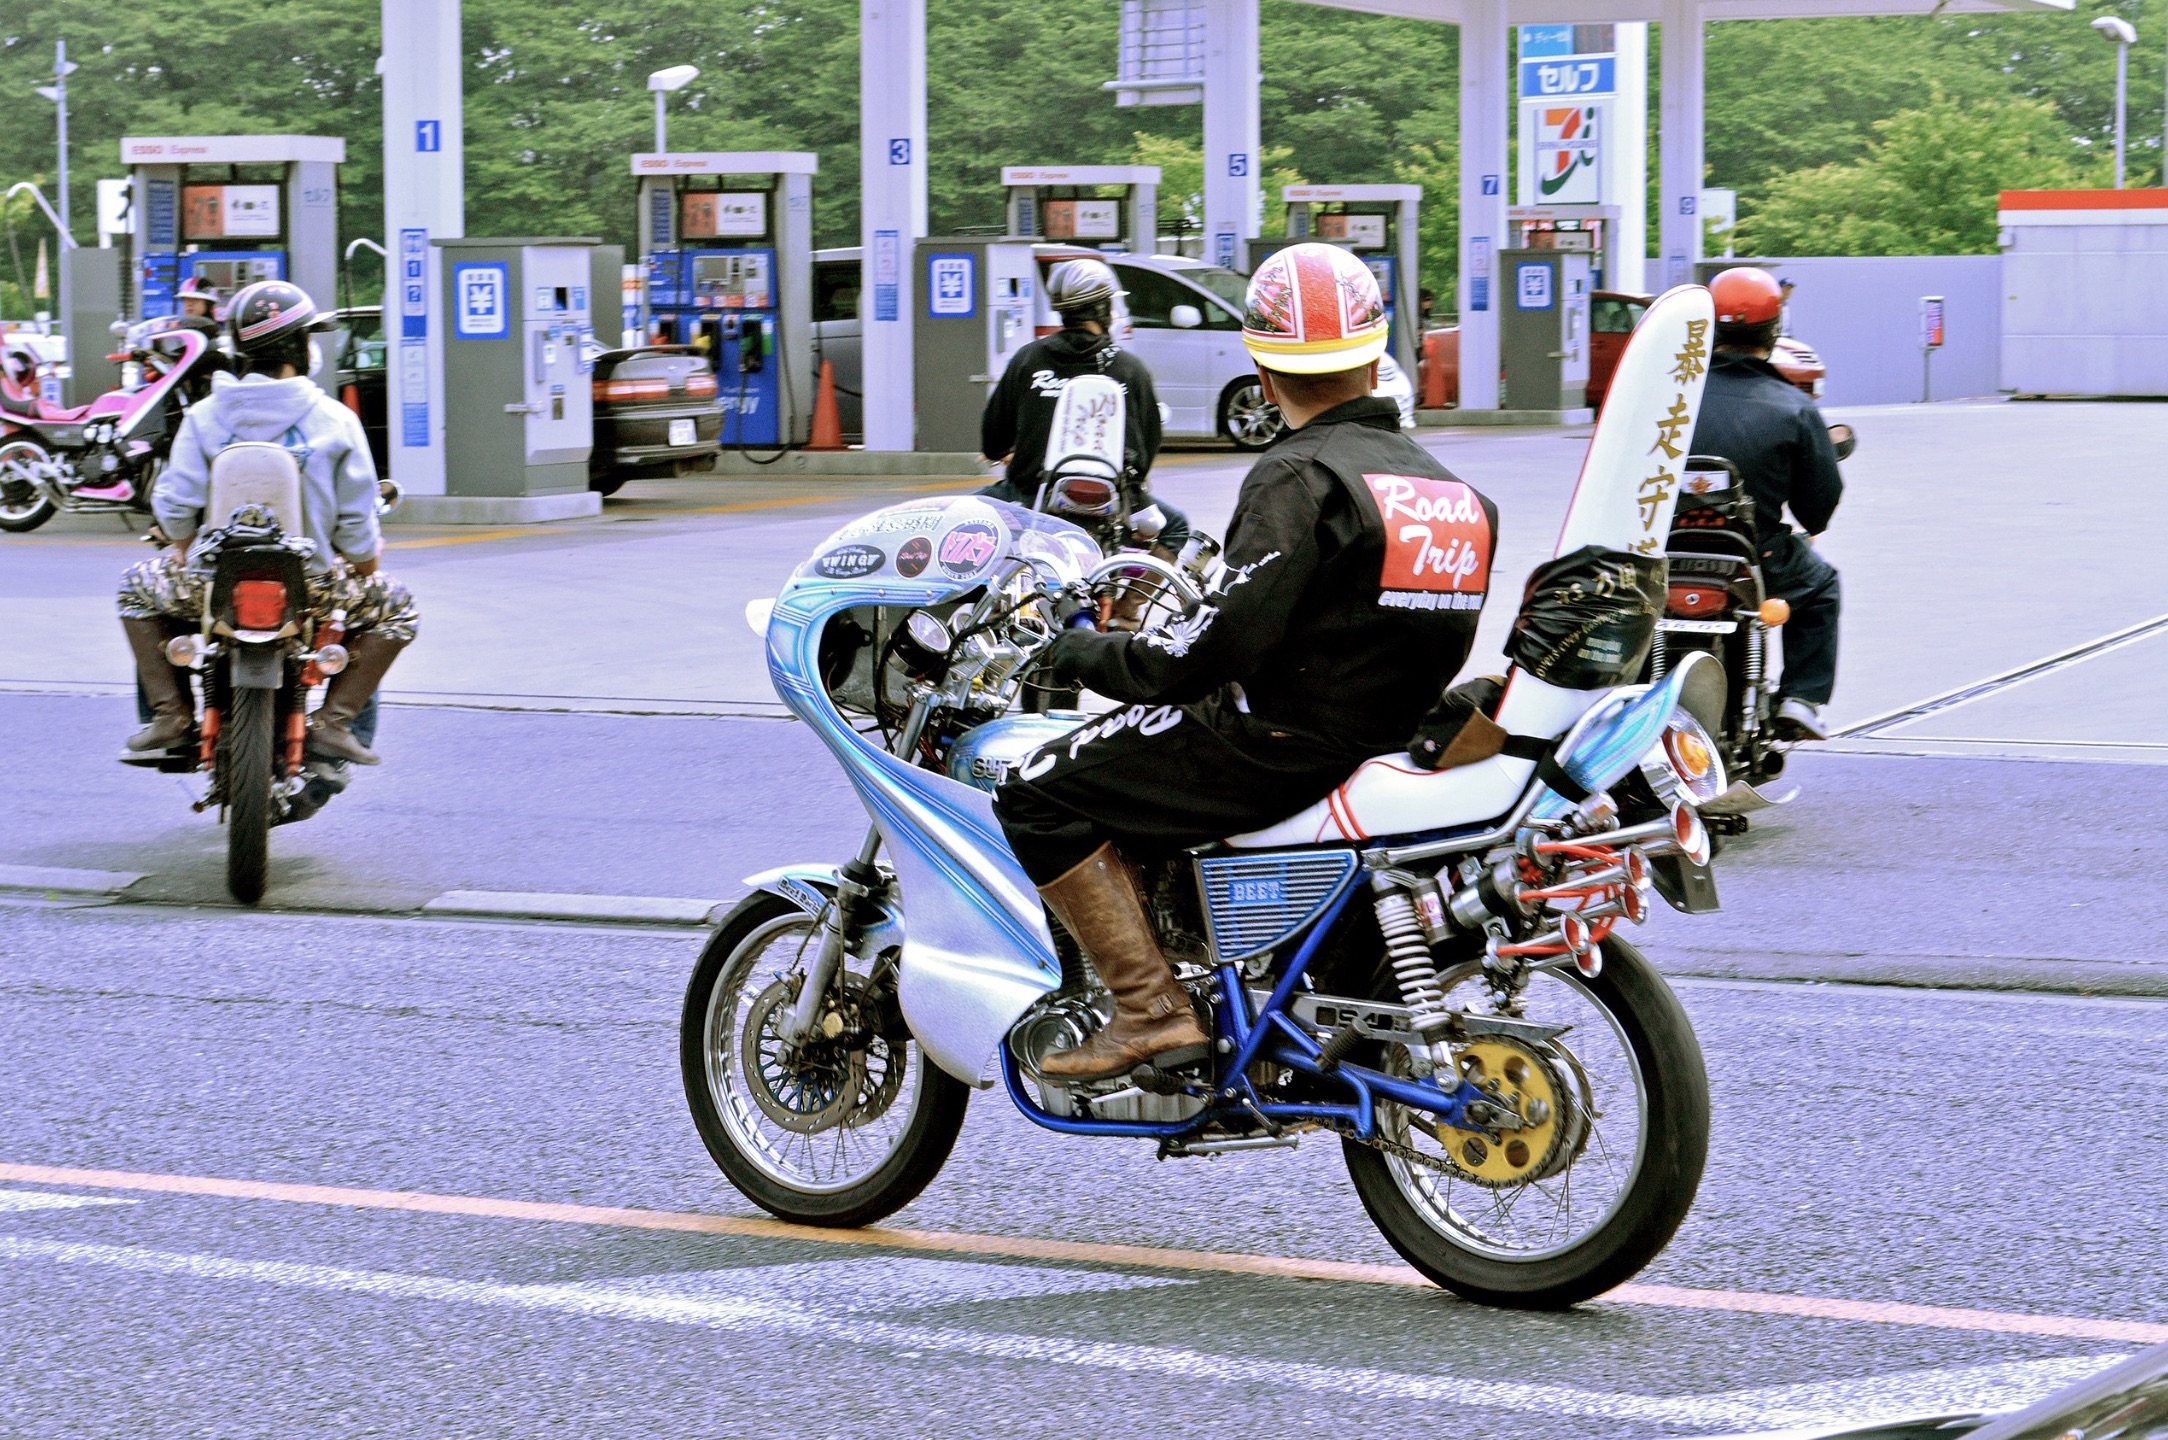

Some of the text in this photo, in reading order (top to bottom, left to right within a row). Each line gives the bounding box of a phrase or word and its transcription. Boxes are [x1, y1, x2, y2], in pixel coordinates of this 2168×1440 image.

[1537, 63, 1599, 93] セルフ
[419, 121, 436, 151] 1
[891, 139, 910, 164] 3
[1230, 154, 1246, 176] 5
[1484, 176, 1498, 194] 7
[1681, 197, 1695, 214] 9
[1373, 475, 1479, 524] Road
[1398, 524, 1479, 589] Trip
[1069, 705, 1183, 760] Road
[1232, 881, 1281, 901] BEET
